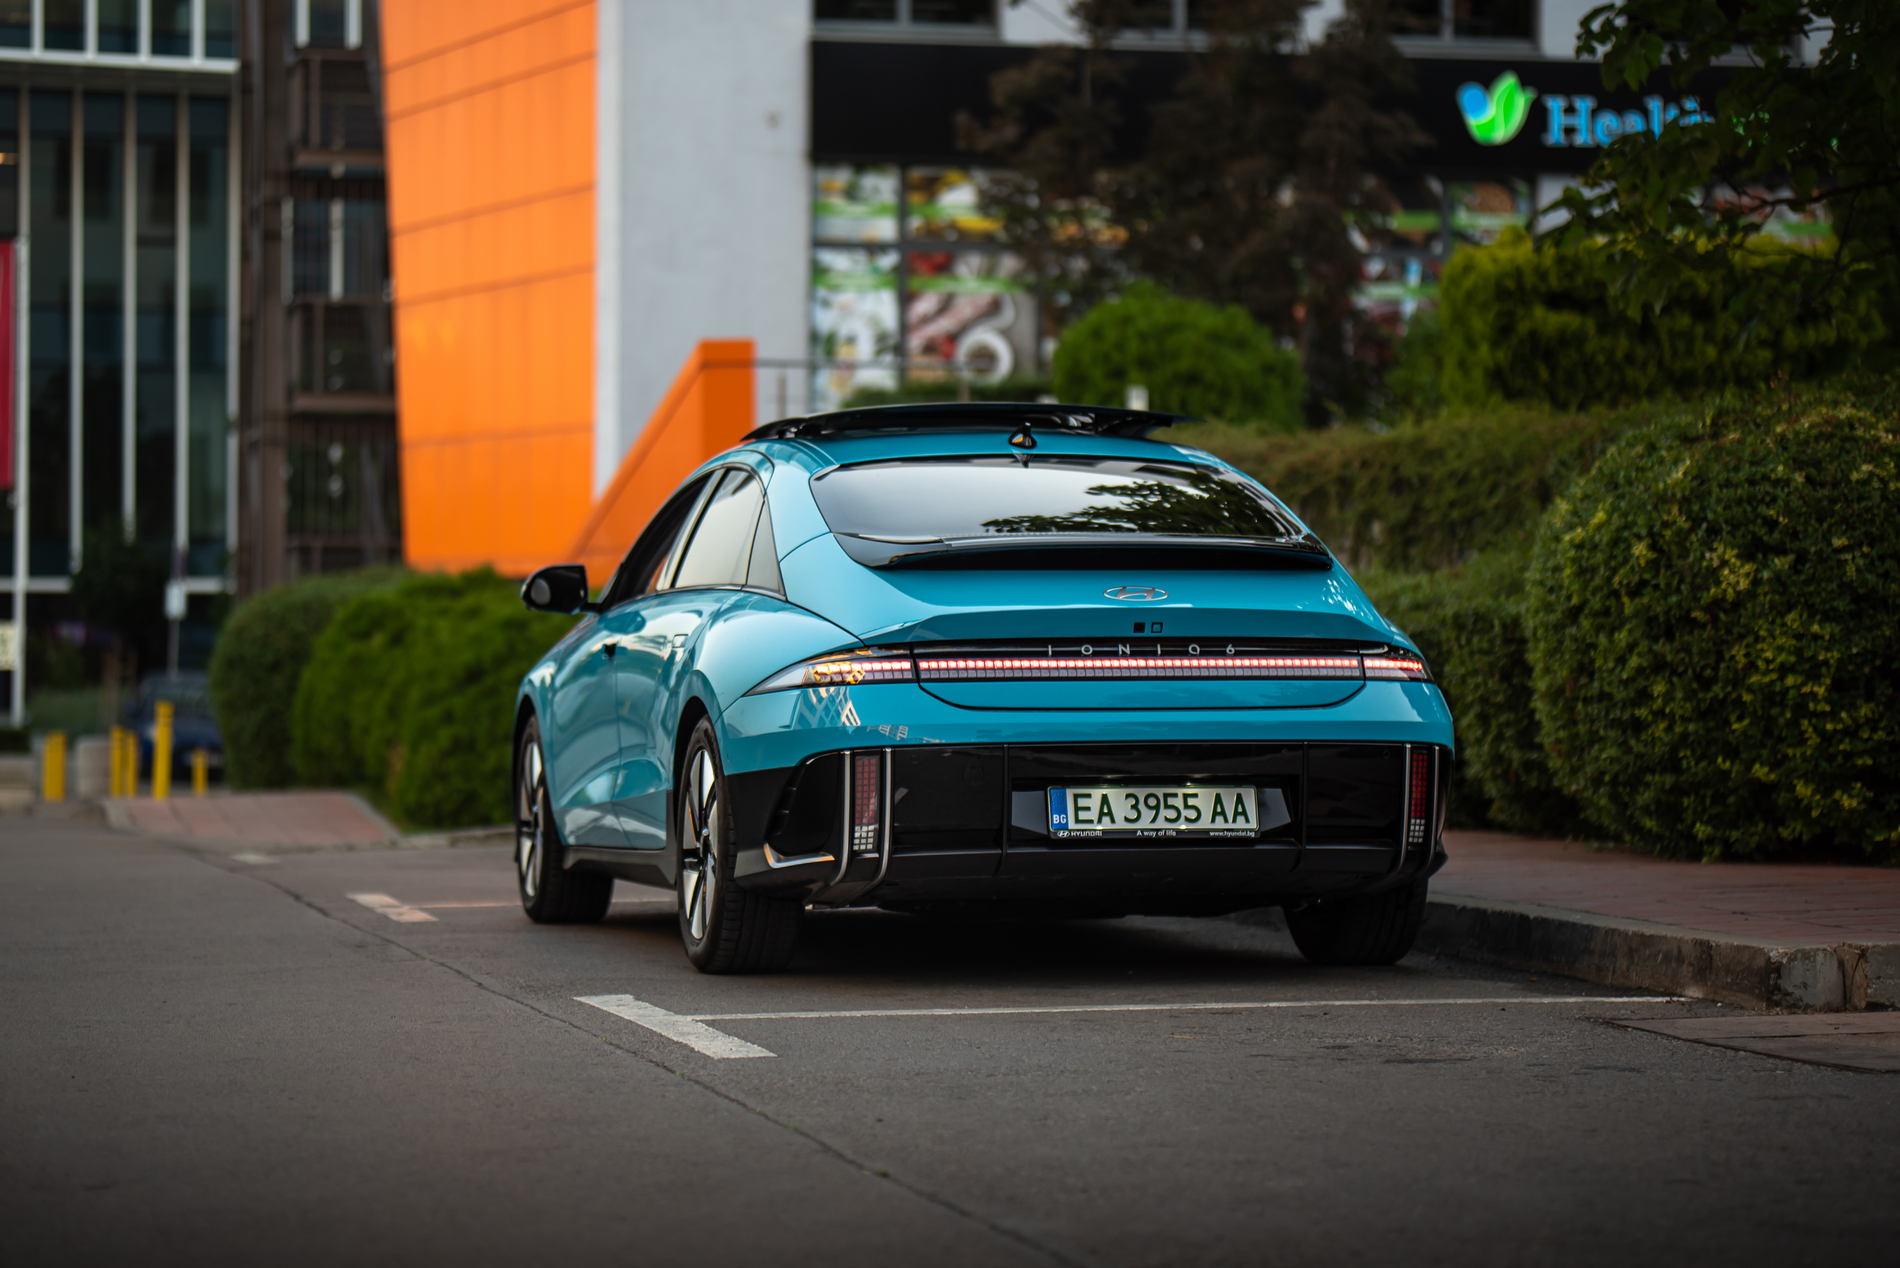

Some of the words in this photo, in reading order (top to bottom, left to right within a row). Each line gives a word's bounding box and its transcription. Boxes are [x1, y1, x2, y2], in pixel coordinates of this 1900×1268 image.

[1053, 814, 1067, 824] BG
[1072, 792, 1116, 825] EA
[1123, 792, 1202, 824] 3955
[1209, 792, 1251, 824] AA
